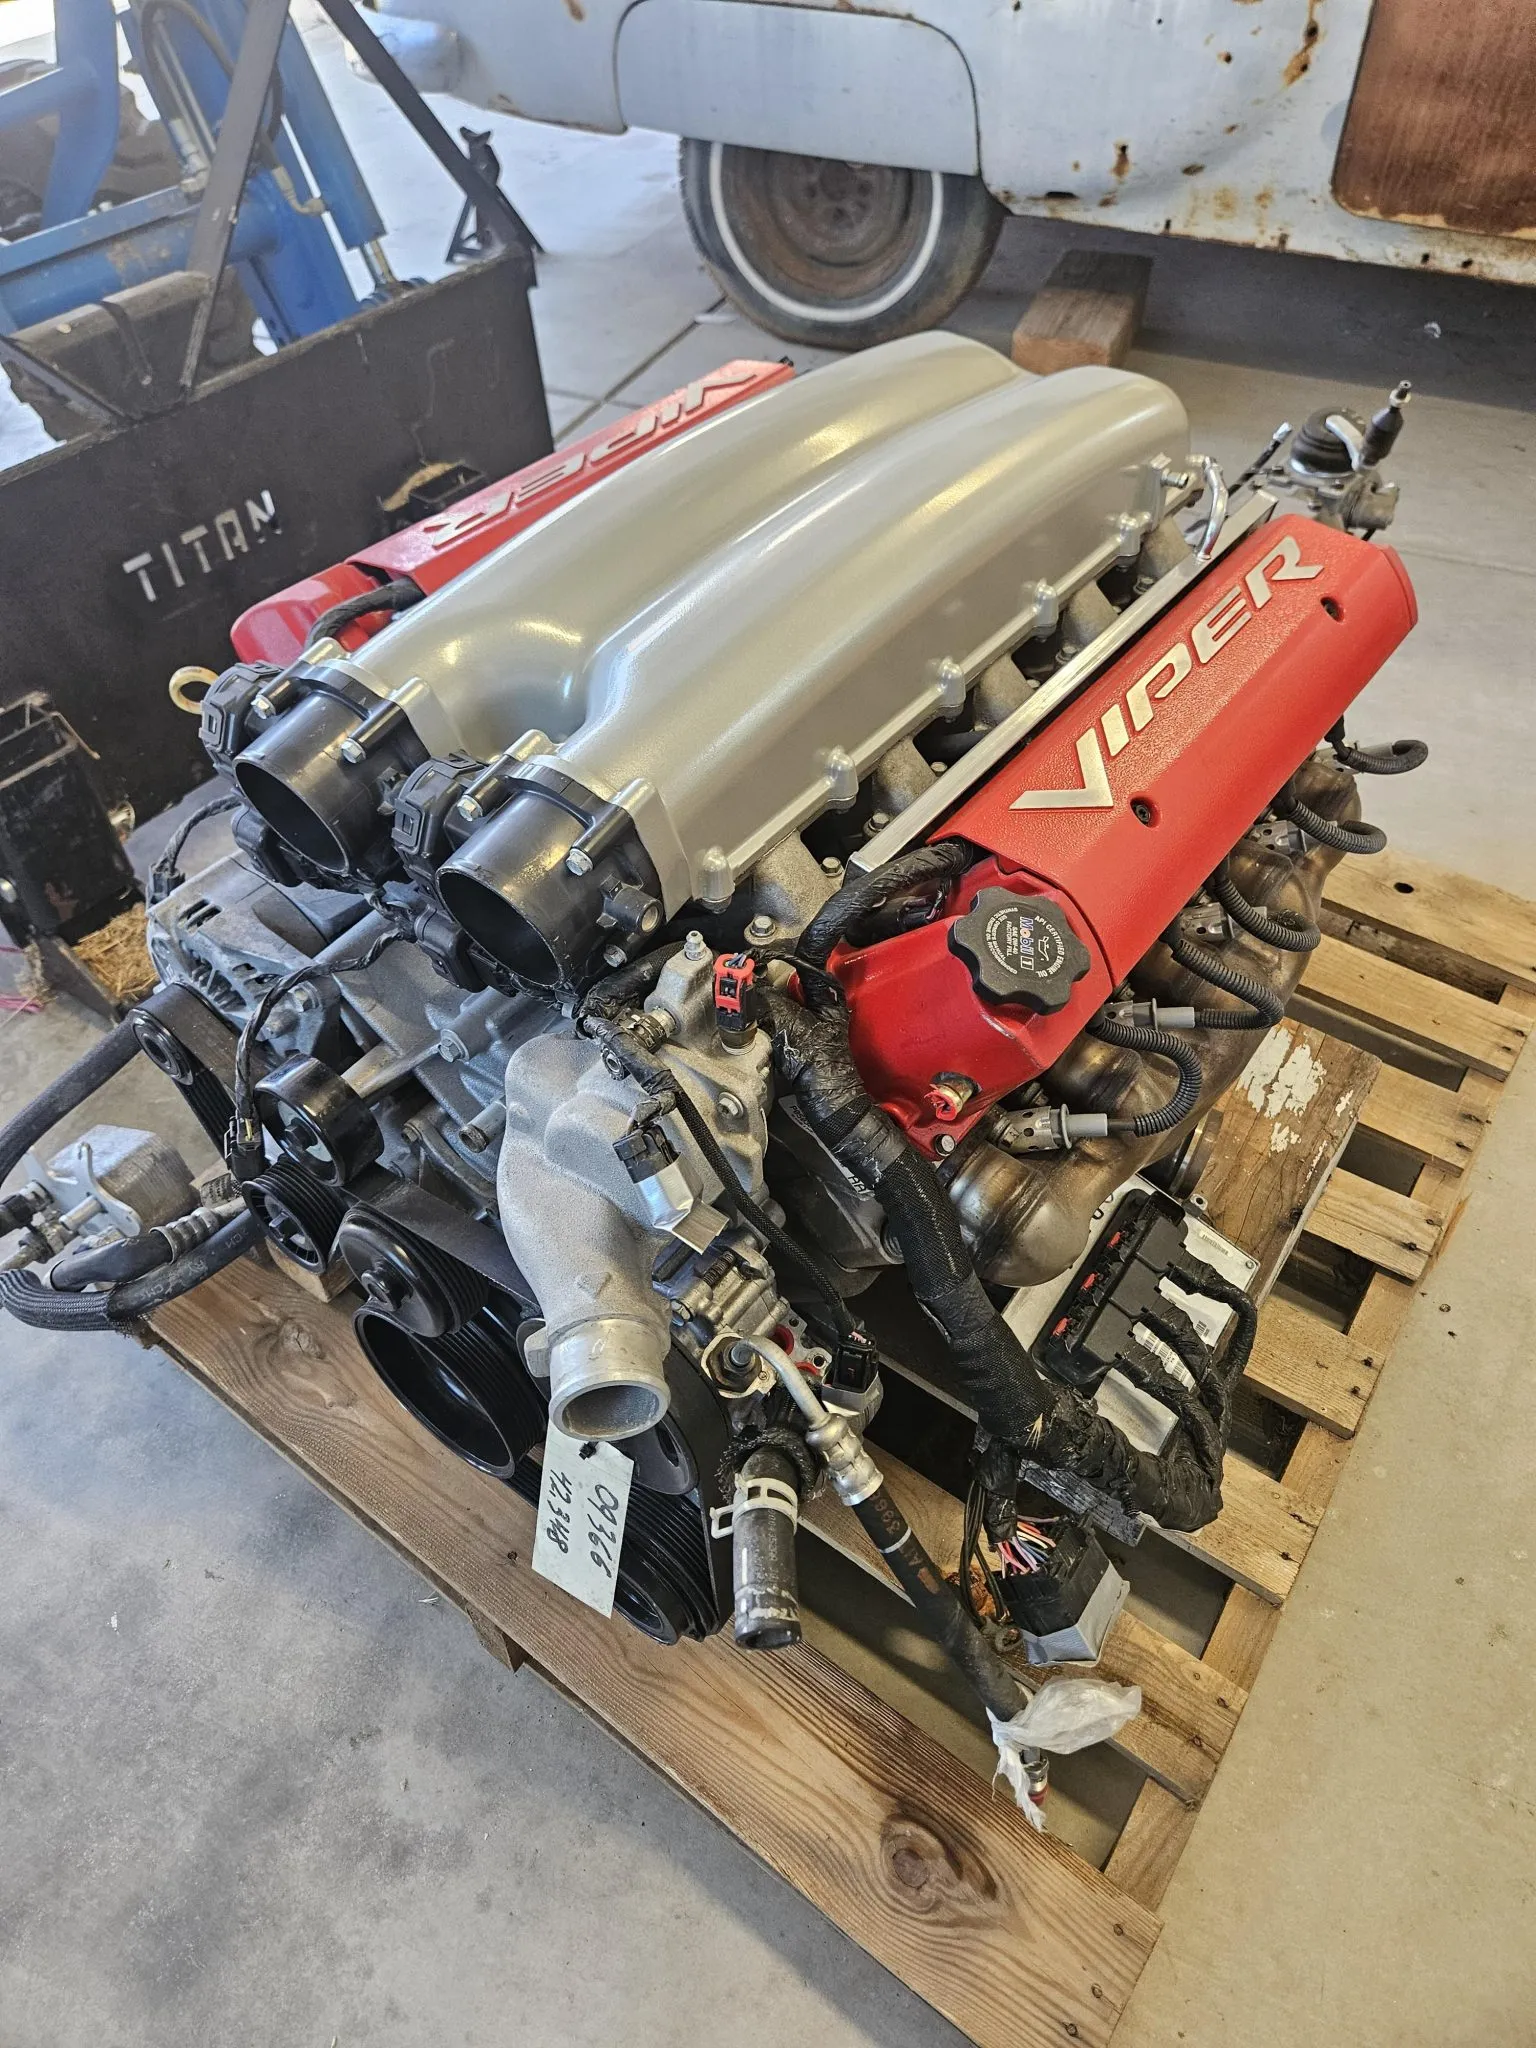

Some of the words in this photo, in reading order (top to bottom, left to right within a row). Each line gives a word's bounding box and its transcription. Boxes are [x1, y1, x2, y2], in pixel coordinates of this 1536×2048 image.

[424, 371, 758, 550] VIPER
[122, 489, 283, 602] TITAN
[1008, 535, 1325, 811] VIPER
[986, 917, 996, 933] ENGINE
[993, 907, 1018, 919] SYNTHETIC
[1034, 915, 1047, 926] API
[992, 941, 1006, 961] MANUAL
[1020, 916, 1034, 955] Mobil
[1046, 924, 1065, 956] CERTIFIED
[987, 941, 1018, 975] RECOMMENDED
[1035, 969, 1048, 978] OIL
[1046, 955, 1065, 975] ENGINE
[587, 1484, 619, 1578] 09366
